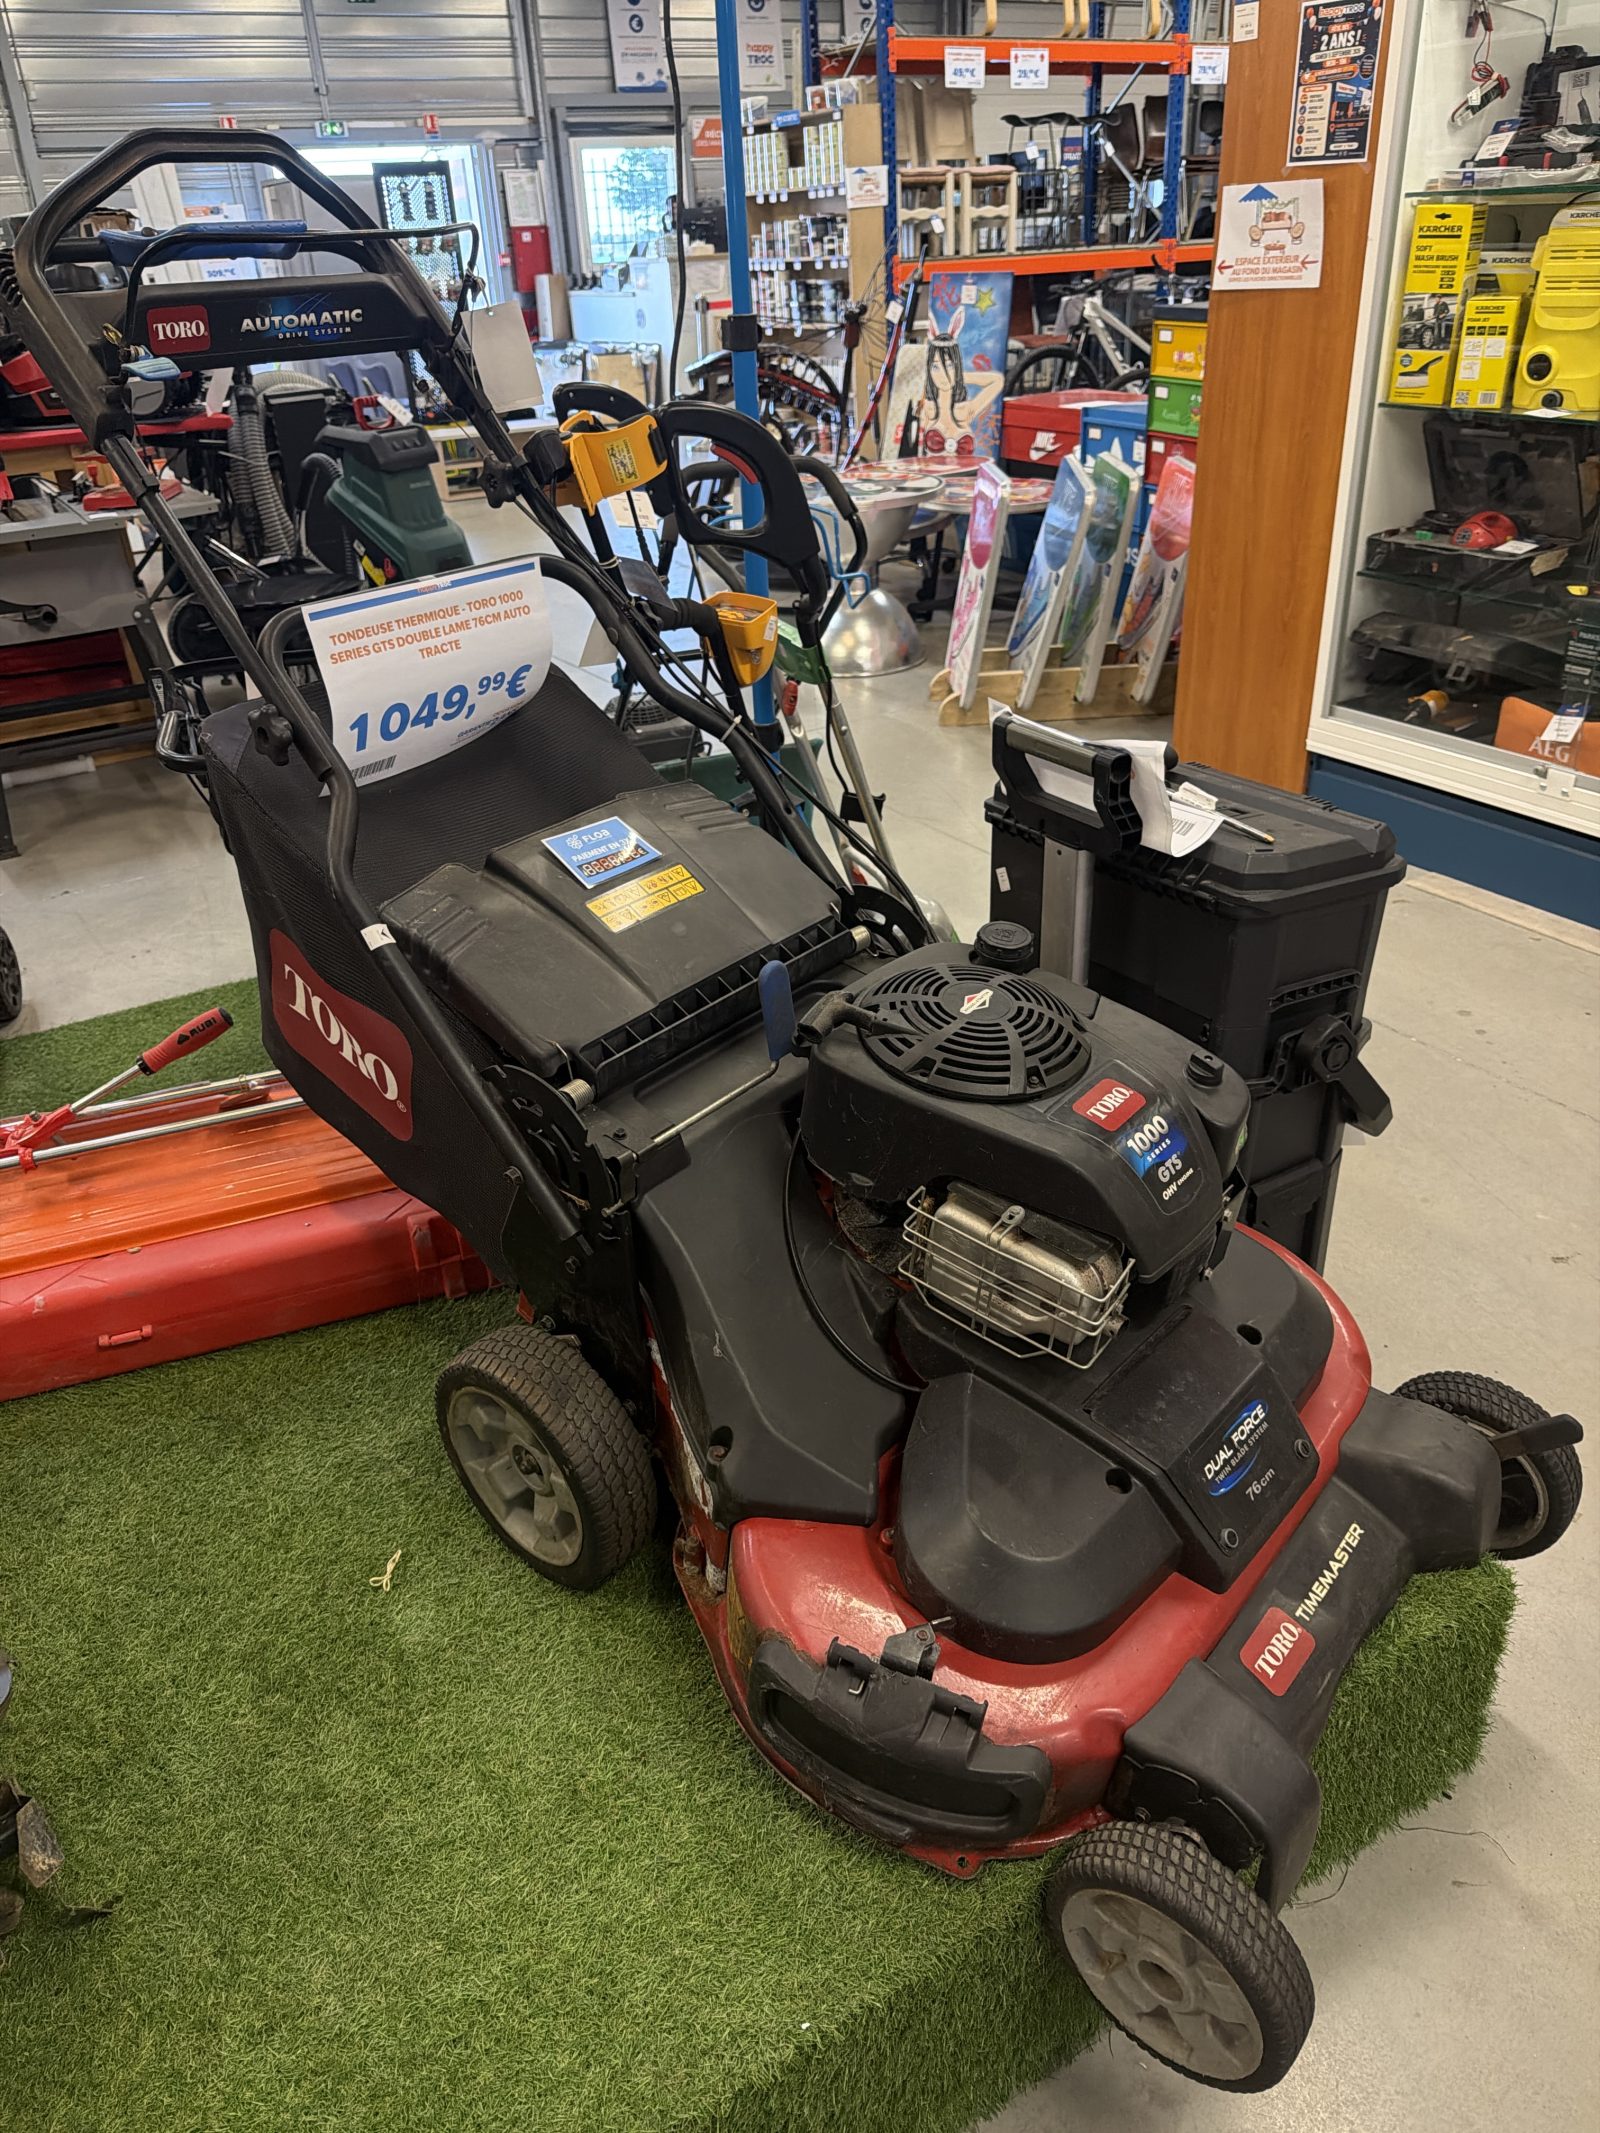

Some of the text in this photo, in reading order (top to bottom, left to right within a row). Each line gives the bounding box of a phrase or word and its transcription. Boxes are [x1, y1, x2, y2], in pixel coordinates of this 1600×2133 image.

[1320, 35, 1328, 51] 2
[1232, 265, 1303, 275] AU FOND DU MAGASIN
[1235, 257, 1260, 266] ESPACE
[153, 308, 363, 341] TORO AUTOMATIC
[278, 326, 352, 339] DRIVE SYSTEM
[329, 620, 394, 646] TONDEUSE
[395, 604, 460, 631] THERMIQUE
[467, 596, 496, 613] TORO
[498, 590, 523, 608] 1000
[330, 604, 531, 665] SERIES GTS DOUBLE LAME 76CM AUTO
[419, 640, 462, 660] TRACTE
[1528, 734, 1570, 764] AEG
[571, 846, 608, 862] PAIEMENT
[609, 842, 620, 850] EN
[189, 1017, 217, 1036] RUBI
[284, 964, 398, 1101] TORO
[1086, 1086, 1131, 1120] TORO
[1127, 1115, 1169, 1156] 1000
[1147, 1139, 1171, 1162] SERIES
[1157, 1154, 1183, 1183] GTS
[1163, 1168, 1194, 1201] OHV ENGINE
[1204, 1403, 1266, 1479] DUAL FORCE
[1215, 1421, 1269, 1484] TWIN BLADE SYSTEM
[1295, 1522, 1366, 1622] TIMEMASTER
[1254, 1621, 1300, 1679] TORO
